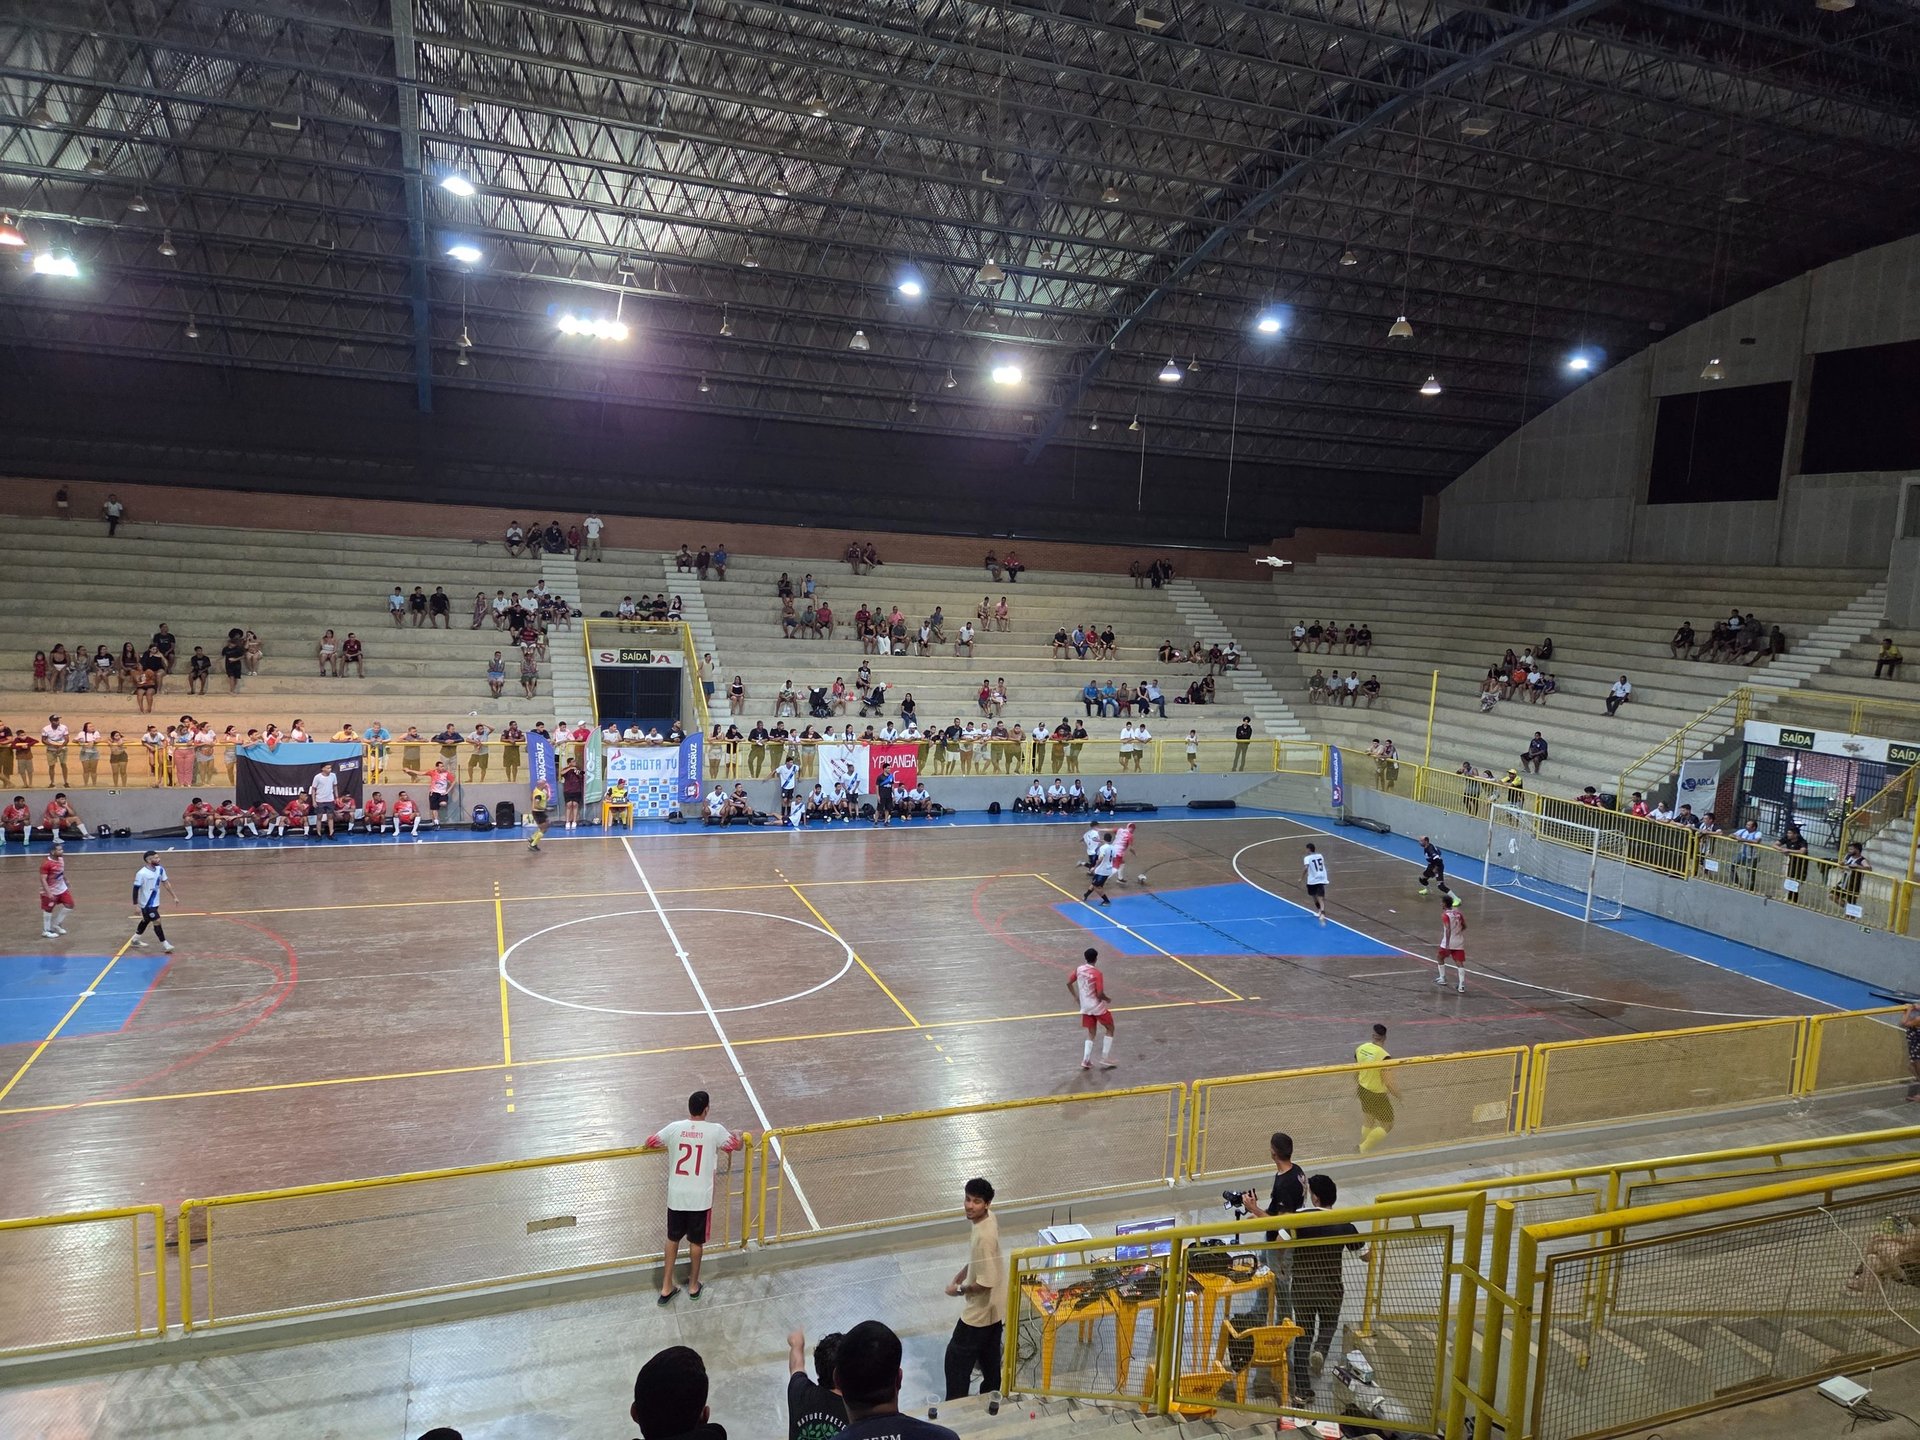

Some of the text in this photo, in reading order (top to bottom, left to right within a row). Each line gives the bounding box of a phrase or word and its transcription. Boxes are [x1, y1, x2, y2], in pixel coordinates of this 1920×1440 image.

[622, 651, 648, 661] SAÍDA
[1782, 732, 1812, 746] SAÍDA
[536, 742, 547, 781] ARACRUZ
[690, 743, 698, 780] ARACRUZ
[1311, 858, 1324, 872] 15
[675, 1143, 703, 1176] 21
